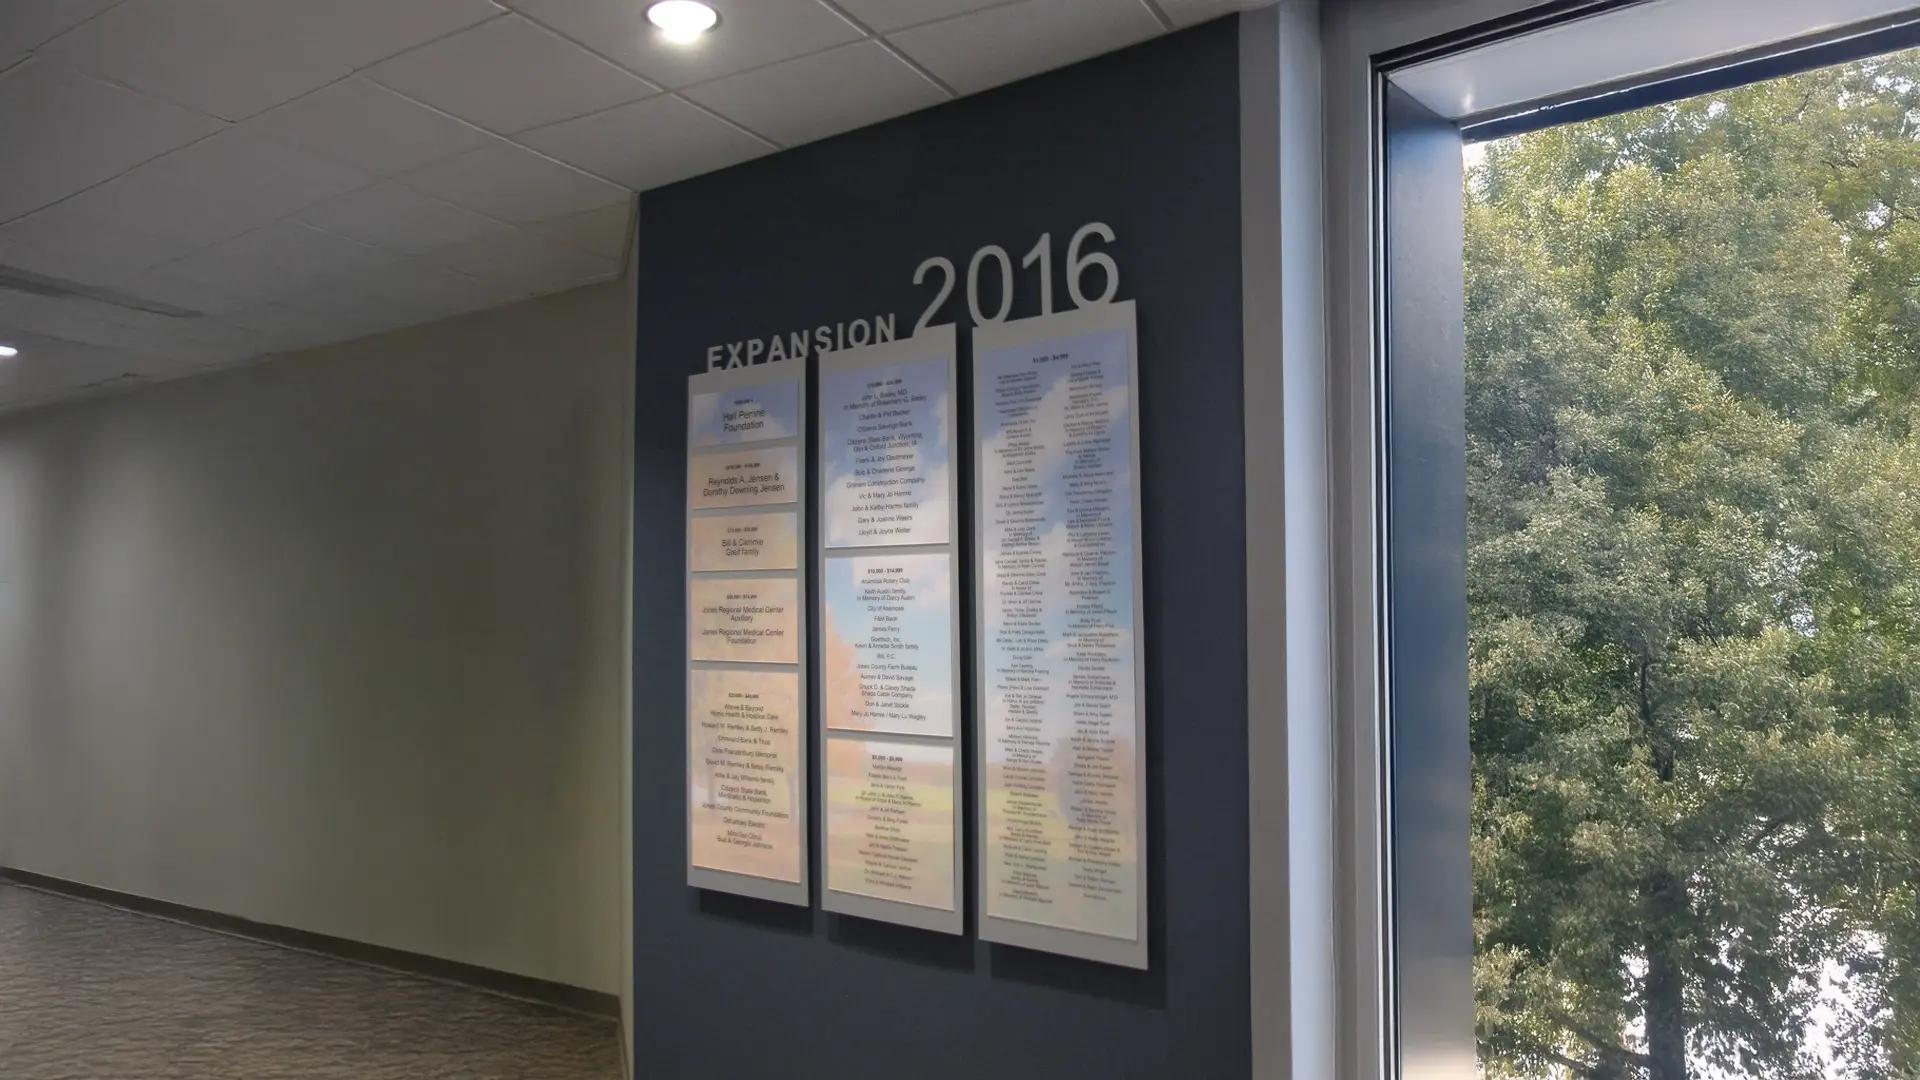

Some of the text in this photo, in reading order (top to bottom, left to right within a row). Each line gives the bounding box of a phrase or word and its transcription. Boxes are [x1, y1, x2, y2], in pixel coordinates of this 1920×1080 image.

[707, 222, 1119, 372] EXPANSION 2016
[724, 420, 764, 432] Foundation
[896, 465, 915, 473] George
[708, 476, 738, 487] Reynolds
[749, 473, 773, 483] Jensen
[774, 472, 780, 481] &
[867, 479, 899, 488] Construction
[703, 486, 729, 497] Dorothy
[760, 483, 784, 493] Jensen
[872, 492, 885, 500] Mary
[862, 595, 880, 603] Memory
[718, 606, 741, 615] Regional
[718, 629, 741, 638] Regional
[743, 629, 764, 637] Medical
[765, 628, 784, 636] Center
[870, 663, 886, 672] County
[888, 711, 900, 720] Mary
